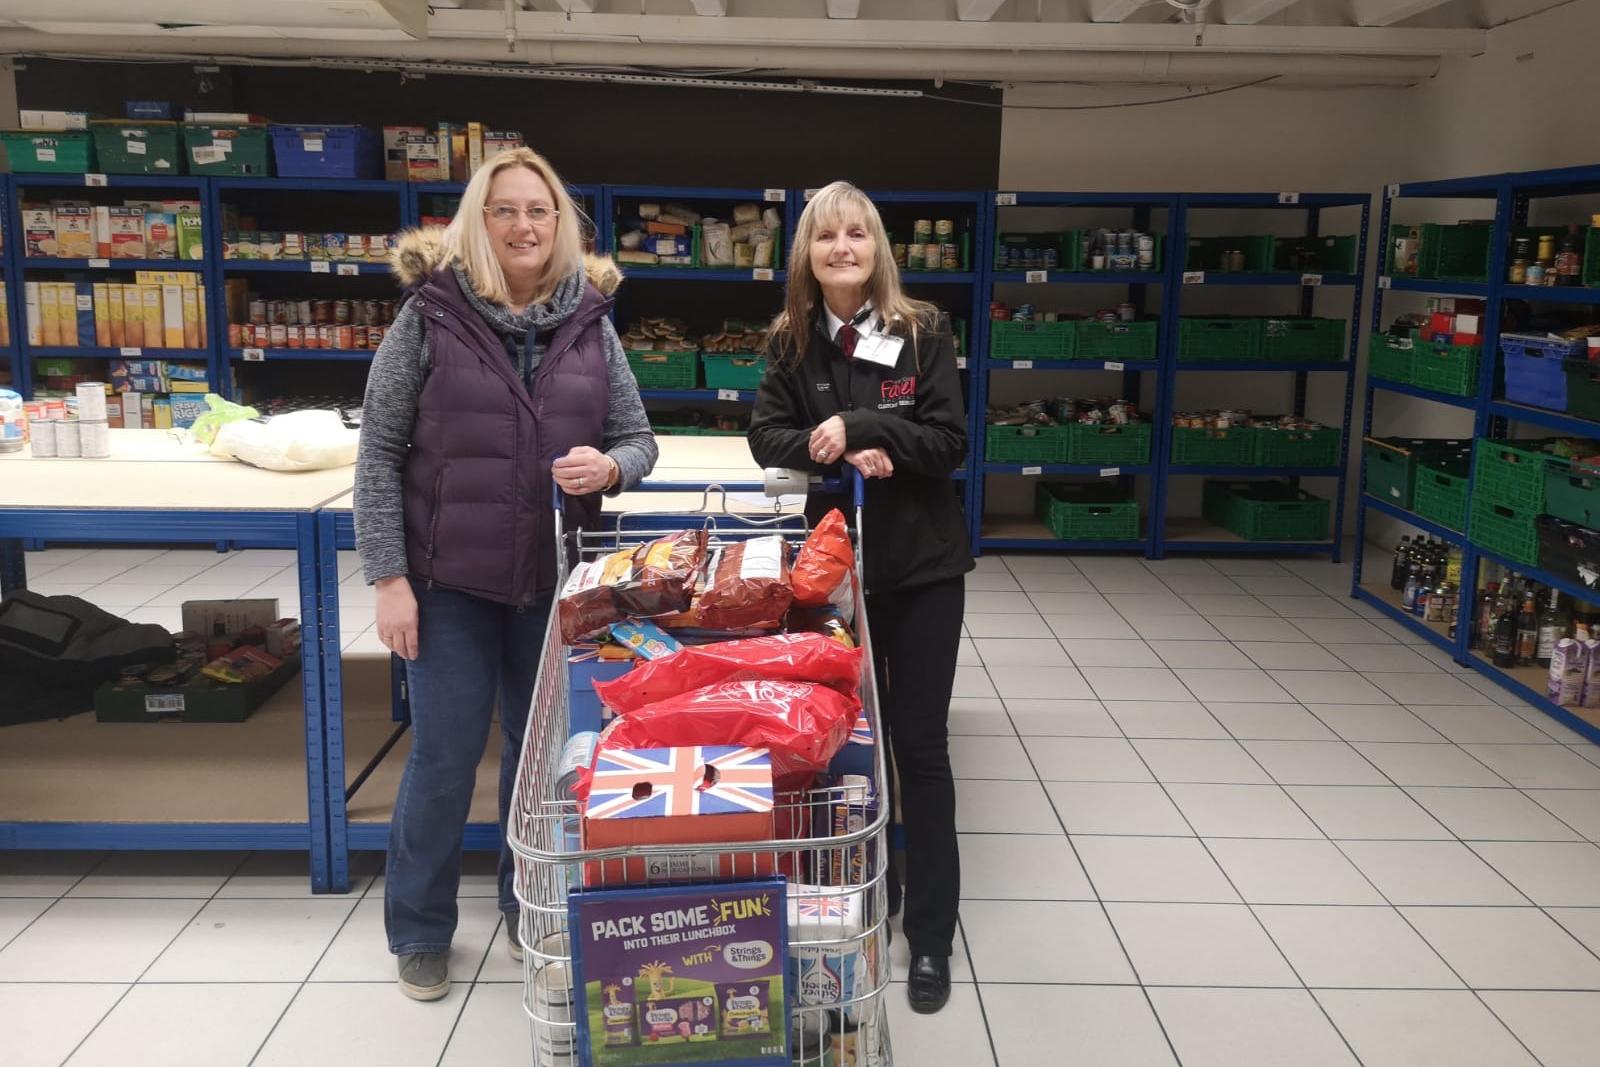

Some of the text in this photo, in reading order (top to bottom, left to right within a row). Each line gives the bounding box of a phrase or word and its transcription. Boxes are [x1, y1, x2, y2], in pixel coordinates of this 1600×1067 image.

[174, 409, 201, 419] RICE
[650, 862, 660, 874] 6
[592, 897, 764, 941] PACK SOME FUN
[624, 924, 736, 950] INTO THEIR LUNCHBOX
[730, 946, 762, 957] Strings
[682, 952, 713, 967] WITH
[731, 953, 767, 963] &Things
